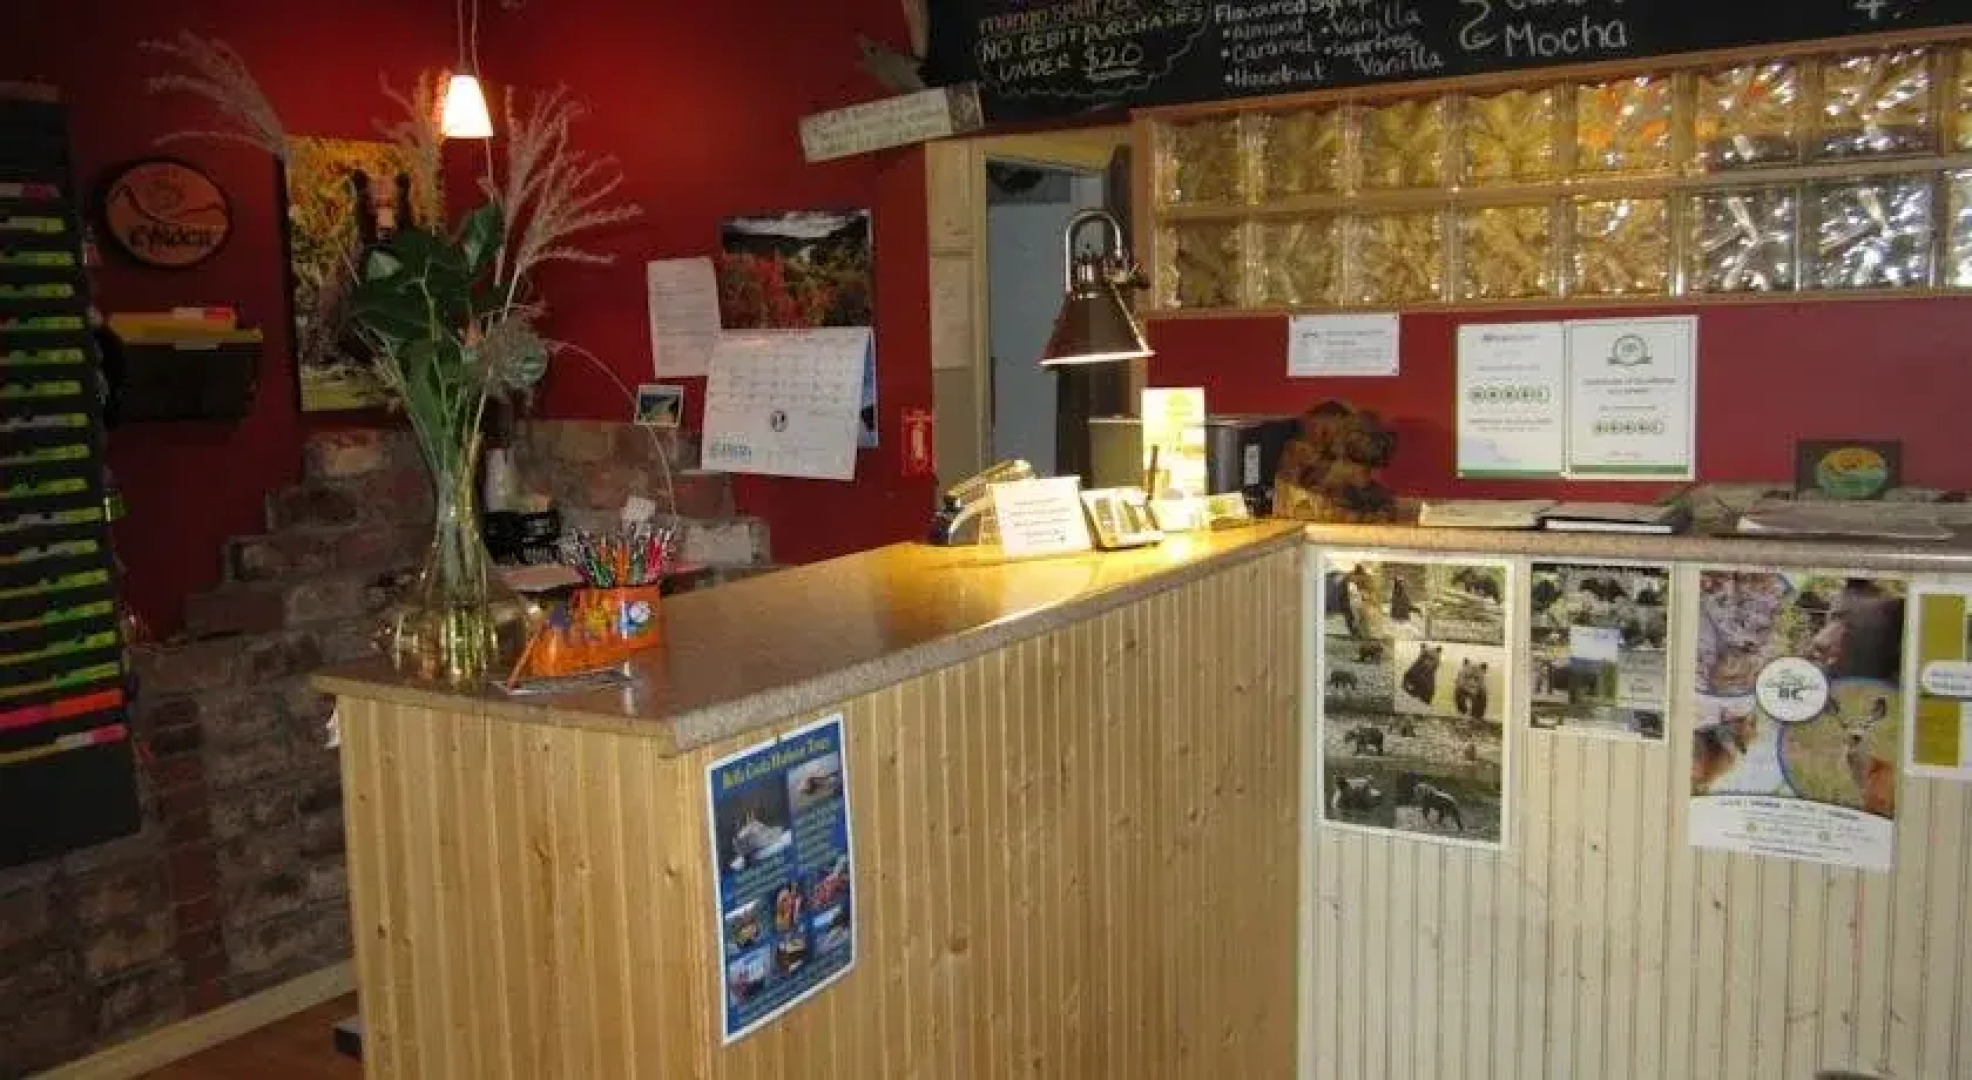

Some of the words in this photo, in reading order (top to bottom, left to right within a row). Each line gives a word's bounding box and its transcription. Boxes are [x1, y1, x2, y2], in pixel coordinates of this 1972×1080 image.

[983, 38, 1015, 63] NO
[1020, 28, 1080, 56] DEBIT
[1083, 6, 1203, 45] PURCHASES
[1231, 32, 1315, 62] Caramel
[1504, 15, 1628, 58] Mocha
[1000, 53, 1071, 82] UNDER
[1083, 42, 1144, 77] $20
[1357, 45, 1444, 76] Vanilla
